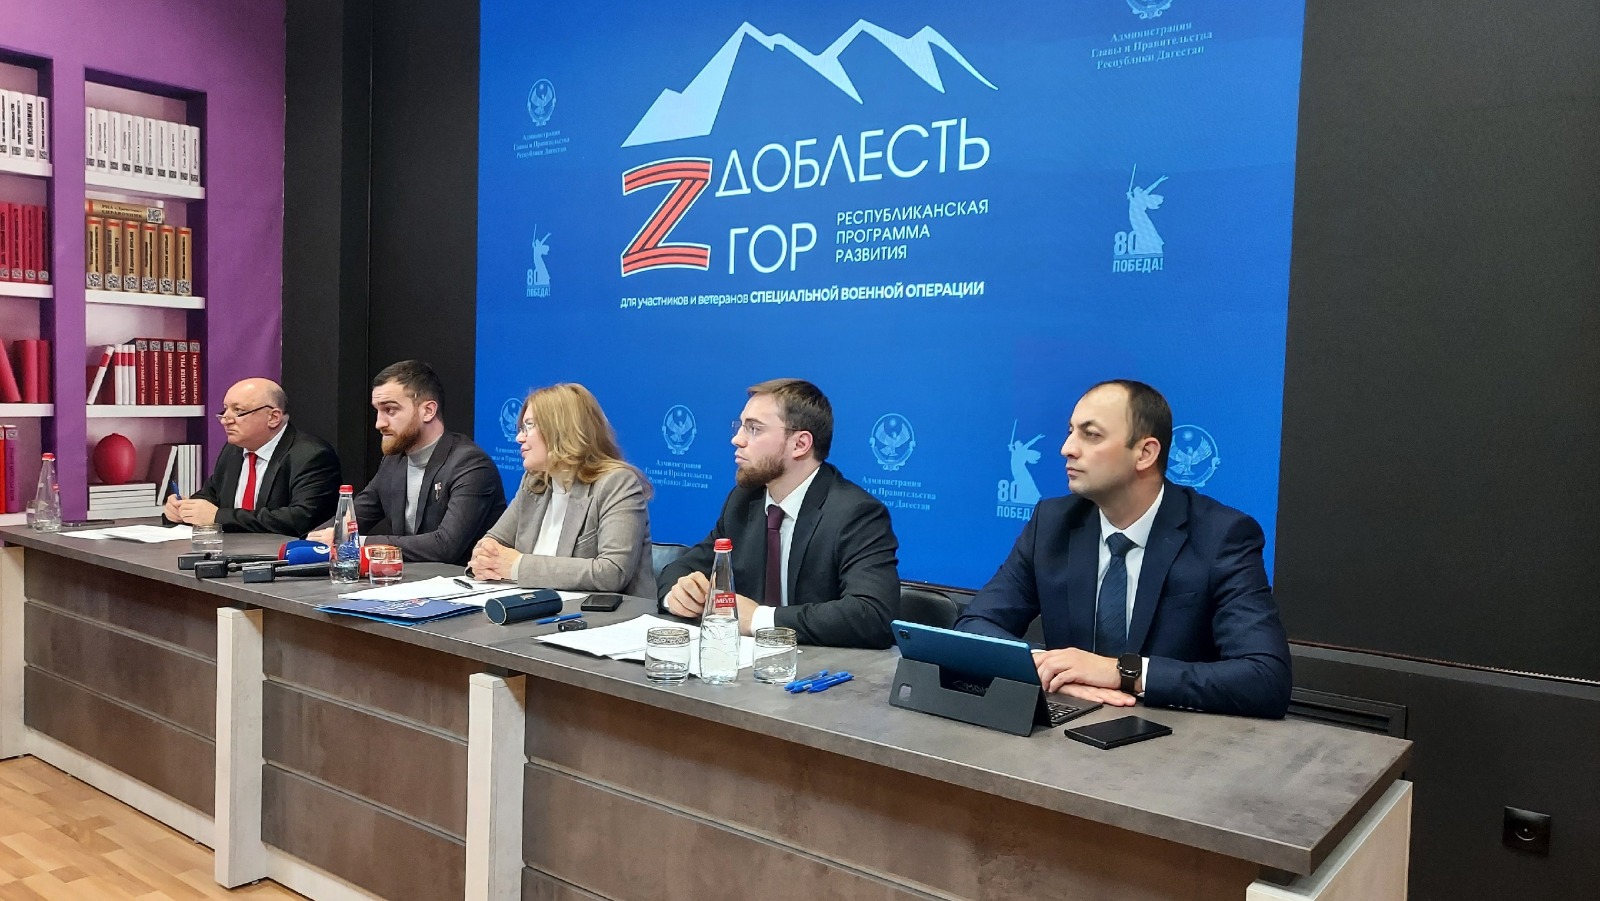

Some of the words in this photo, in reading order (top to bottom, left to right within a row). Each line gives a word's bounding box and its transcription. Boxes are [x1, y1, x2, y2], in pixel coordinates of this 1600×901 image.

[1110, 22, 1192, 42] Администрация
[1092, 47, 1122, 58] Главы
[1124, 45, 1130, 53] и
[1133, 31, 1212, 52] Правительства
[1097, 54, 1154, 70] Республики
[1156, 45, 1204, 62] Дагестан
[715, 117, 991, 198] ДОБЛЕСТЬ
[836, 198, 989, 226] РЕСПУБЛИКАНСКАЯ
[836, 224, 931, 244] ПРОГРАММА
[1114, 231, 1137, 256] 80
[729, 222, 818, 274] ГОР
[835, 245, 907, 263] РАЗВИТИЯ
[1112, 258, 1164, 273] ПОБЕДА!
[526, 268, 538, 286] 80
[526, 287, 550, 298] ПОБЕДА!
[620, 297, 636, 308] для
[637, 295, 688, 308] участников
[690, 296, 697, 305] и
[698, 294, 748, 306] ветеранов
[750, 285, 838, 304] СПЕЦИАЛЬНОЙ
[841, 282, 904, 300] ВОЕННОЙ
[906, 280, 985, 298] ОПЕРАЦИИ
[862, 476, 922, 488] Администрация
[998, 480, 1019, 503] 80
[878, 488, 936, 500] Правительства
[895, 500, 930, 510] Дагестан
